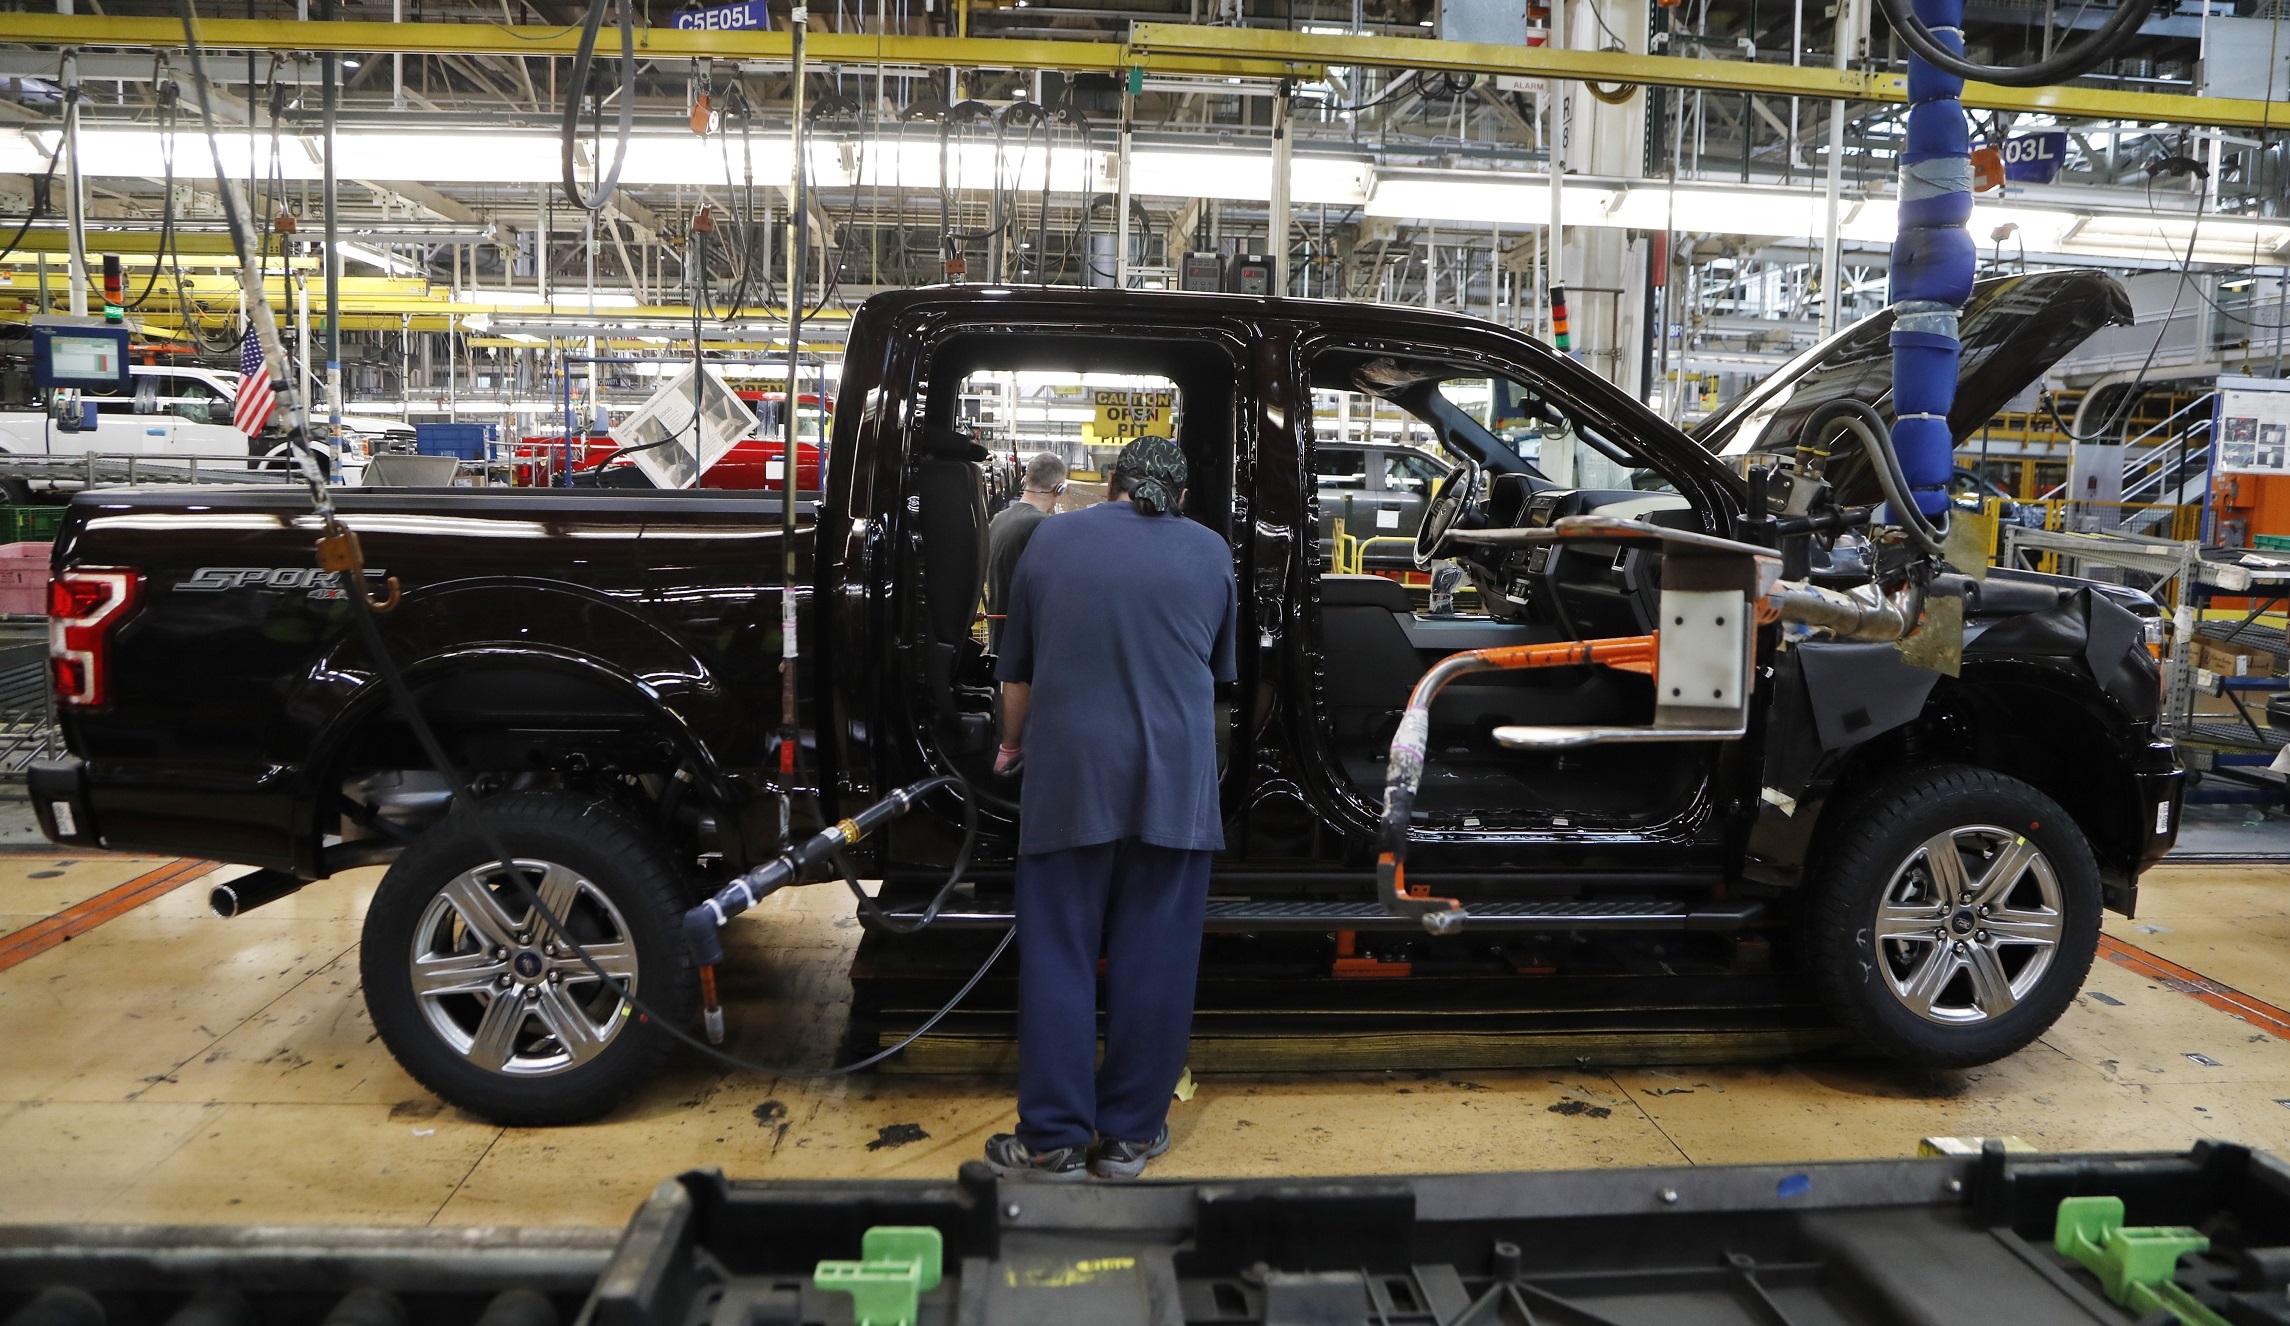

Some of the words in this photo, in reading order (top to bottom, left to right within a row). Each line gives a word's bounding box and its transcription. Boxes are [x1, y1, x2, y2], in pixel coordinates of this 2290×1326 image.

[678, 5, 757, 30] C5E05L
[1513, 81, 1545, 91] ALARM
[1097, 392, 1168, 405] CAUTON
[659, 405, 673, 420] GOOD
[1107, 407, 1158, 421] OPEN
[1118, 423, 1148, 436] PIT
[172, 567, 387, 592] SPOR
